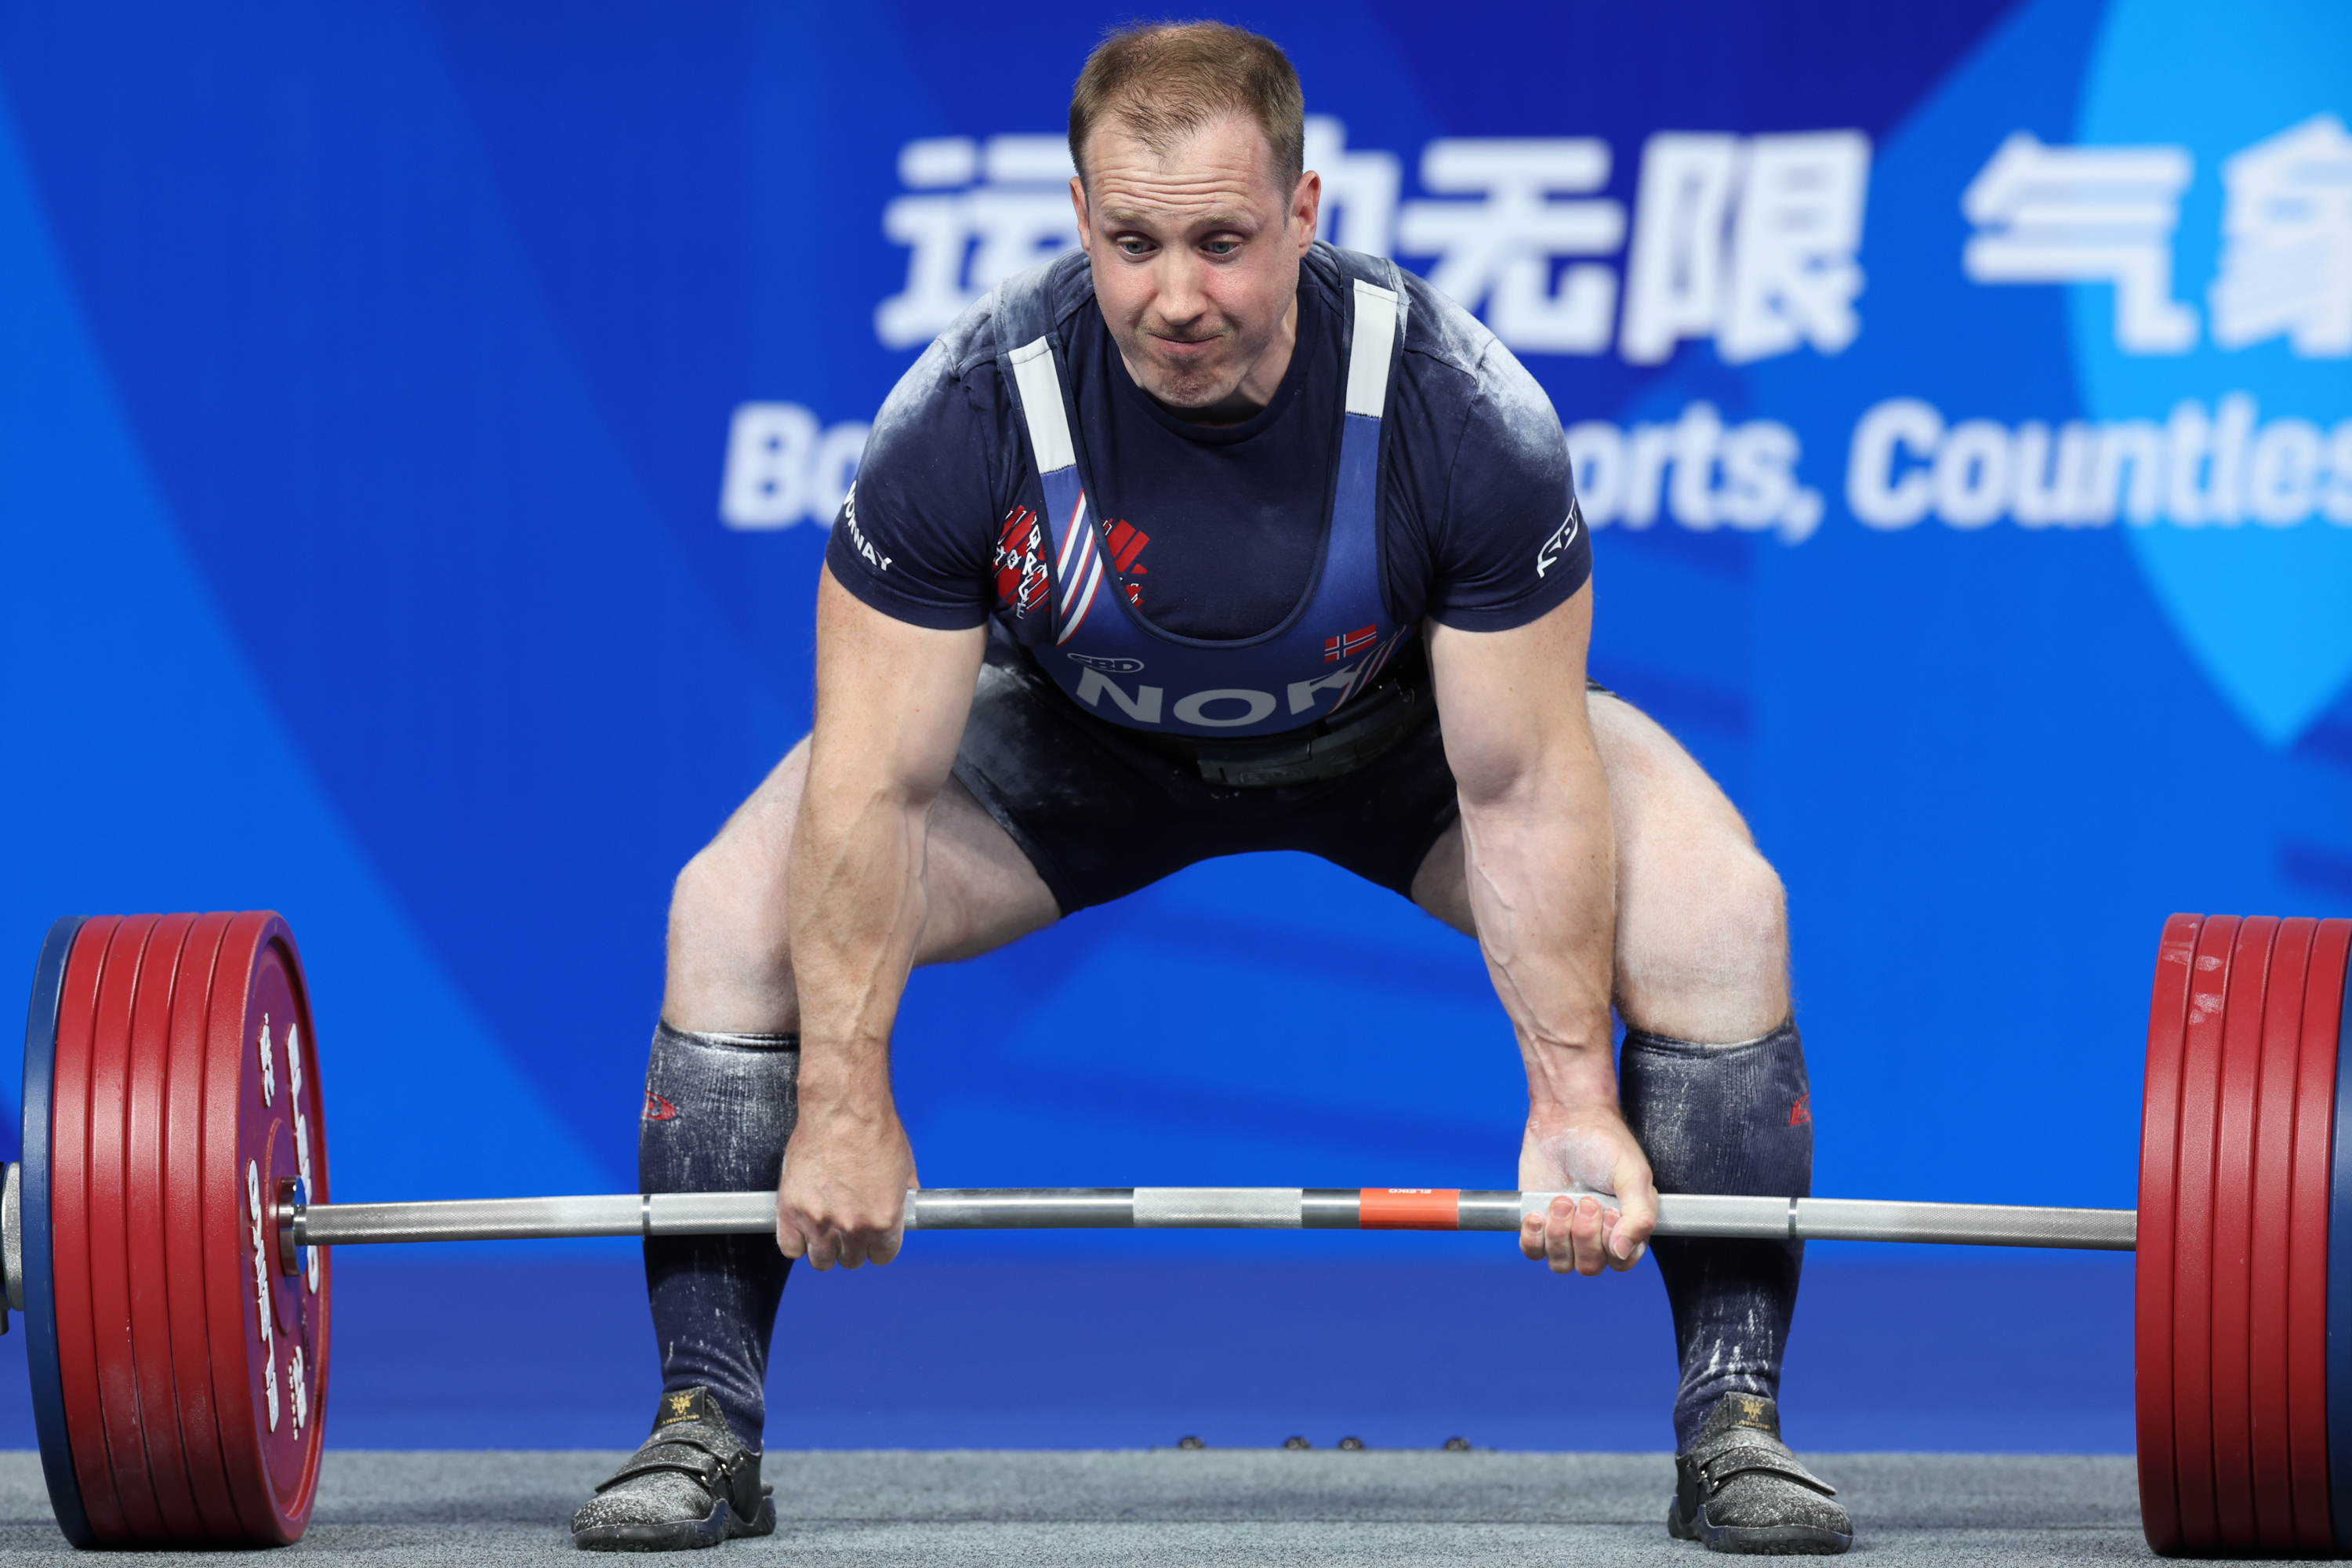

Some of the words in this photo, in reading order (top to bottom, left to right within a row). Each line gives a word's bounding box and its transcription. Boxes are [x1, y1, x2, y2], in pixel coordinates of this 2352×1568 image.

[878, 121, 1870, 362] 运无限
[1570, 401, 1824, 543] orts,
[249, 1159, 280, 1433] ELEIKO
